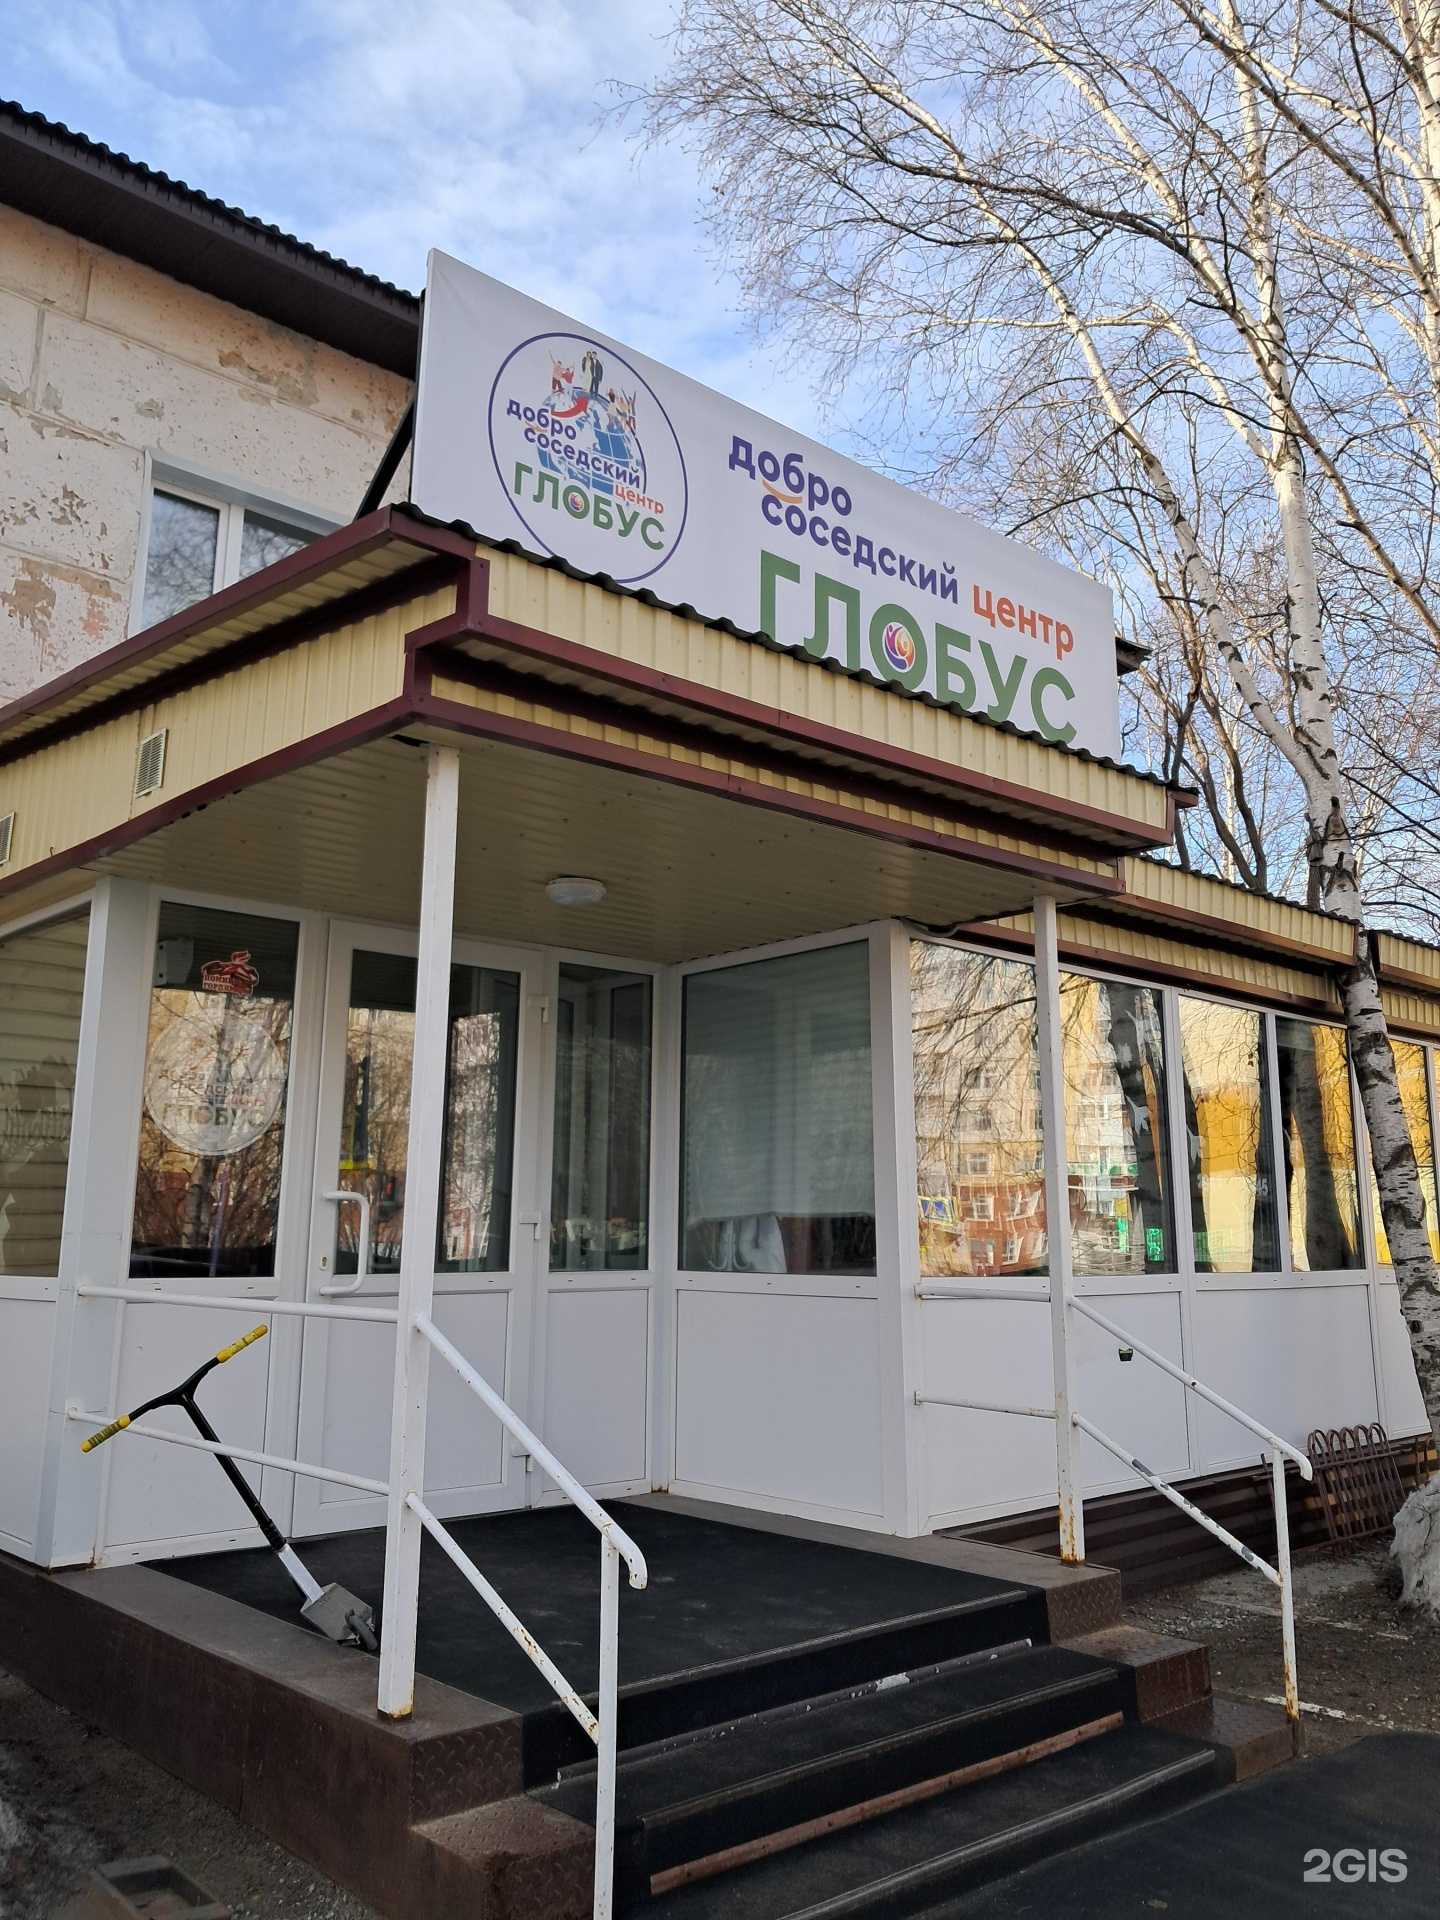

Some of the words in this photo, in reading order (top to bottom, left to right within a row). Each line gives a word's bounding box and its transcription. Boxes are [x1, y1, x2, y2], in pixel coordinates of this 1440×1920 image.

[506, 400, 577, 441] добро
[524, 426, 641, 489] соседский
[513, 462, 665, 550] ГЛОБУС
[614, 483, 664, 515] центр
[728, 435, 852, 516] добро
[761, 494, 959, 604] соседский
[972, 584, 1074, 660] центр
[760, 549, 1078, 744] ГЛОБУС
